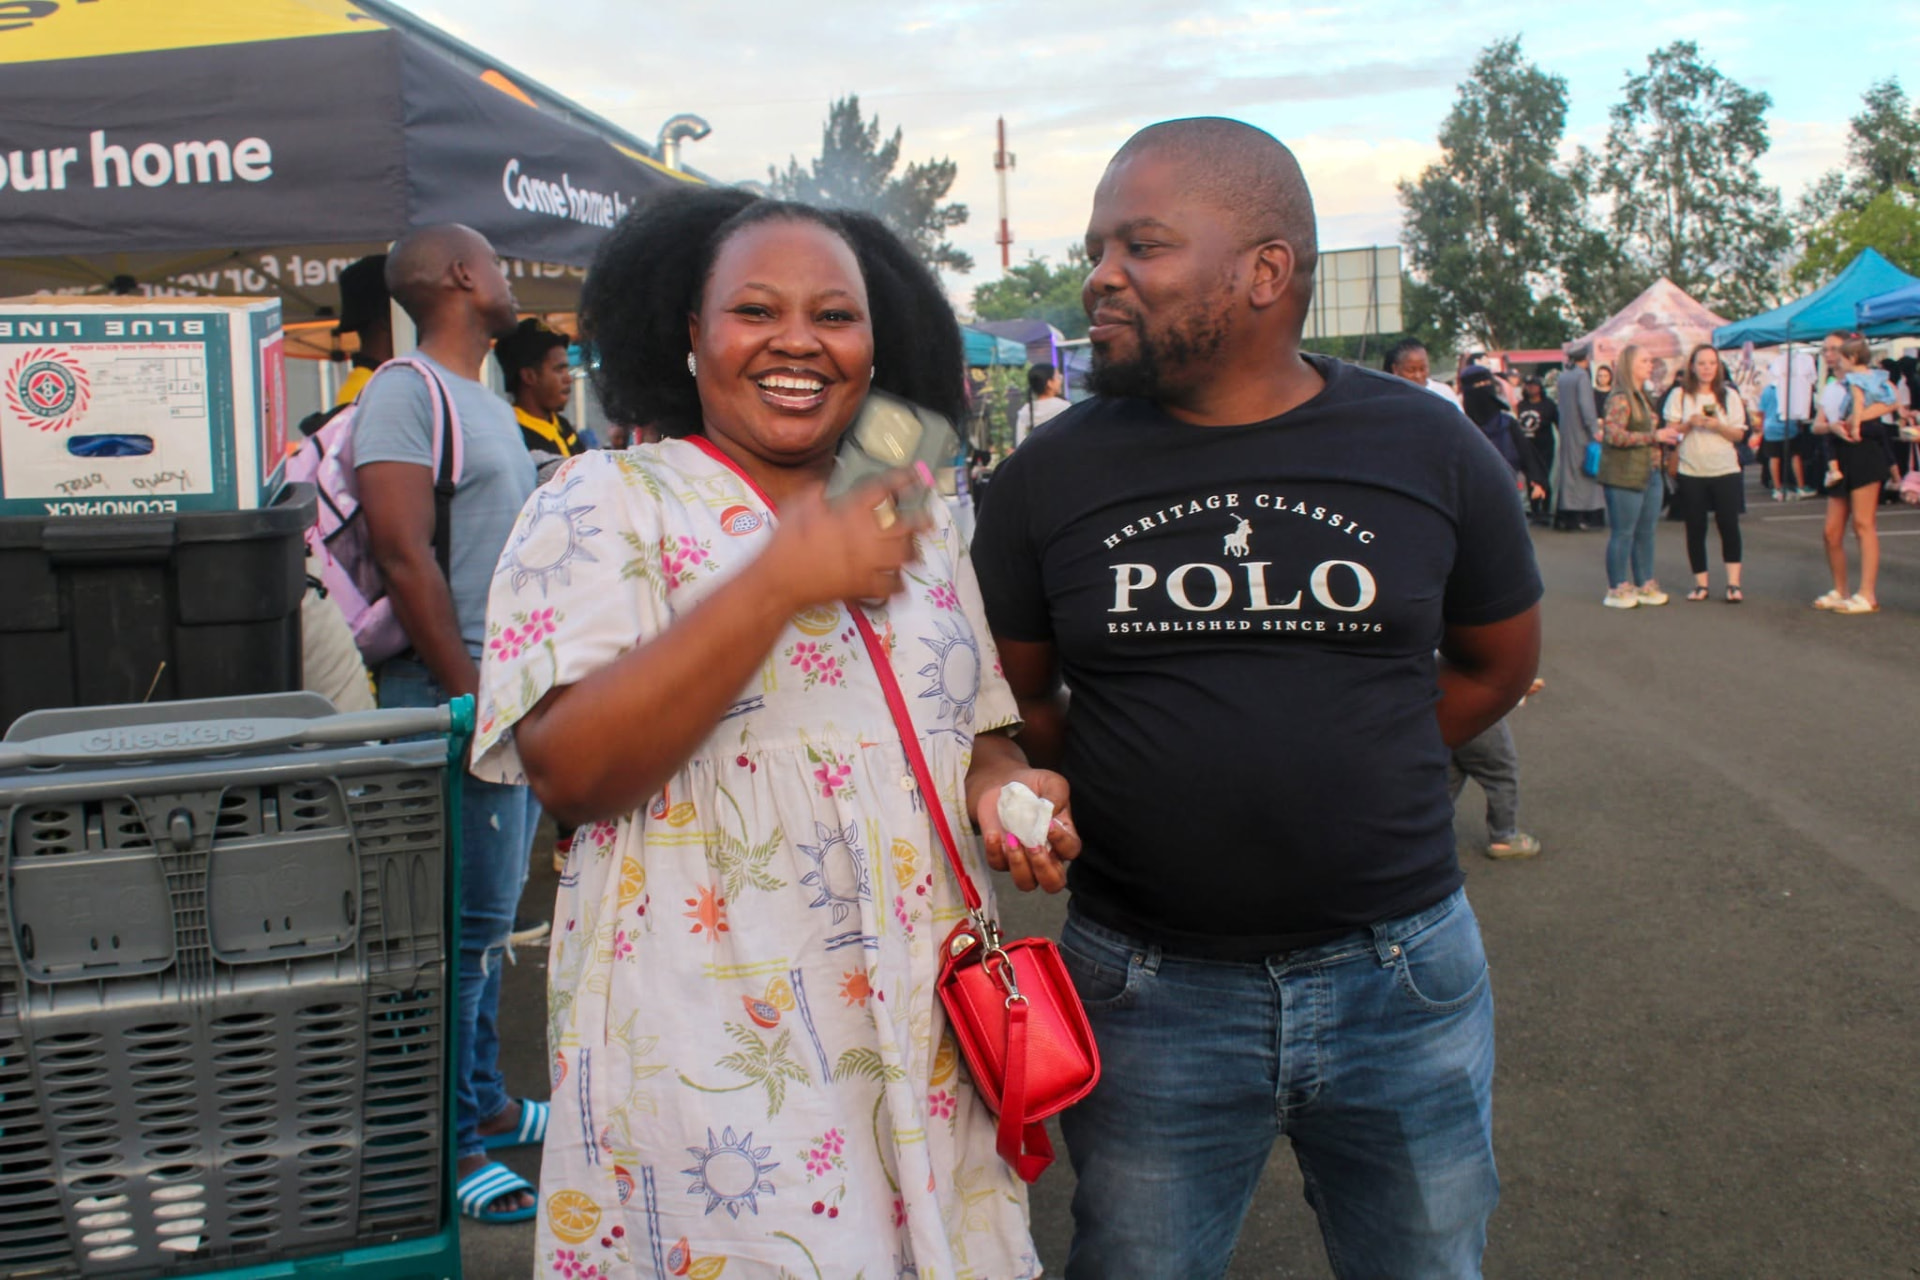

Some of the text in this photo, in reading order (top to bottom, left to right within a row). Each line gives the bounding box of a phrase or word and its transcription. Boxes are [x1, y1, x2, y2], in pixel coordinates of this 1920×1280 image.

[0, 130, 273, 192] ur home
[502, 158, 569, 218] Come
[562, 172, 616, 229] home
[0, 320, 205, 337] BLUE LINE
[44, 499, 178, 517] ECONOPACK
[1103, 493, 1375, 549] HERITAGE CLASSIC
[1107, 560, 1377, 612] POLO
[1107, 620, 1383, 634] ESTABLISHED SINCE 1976
[81, 725, 256, 753] Checkers
